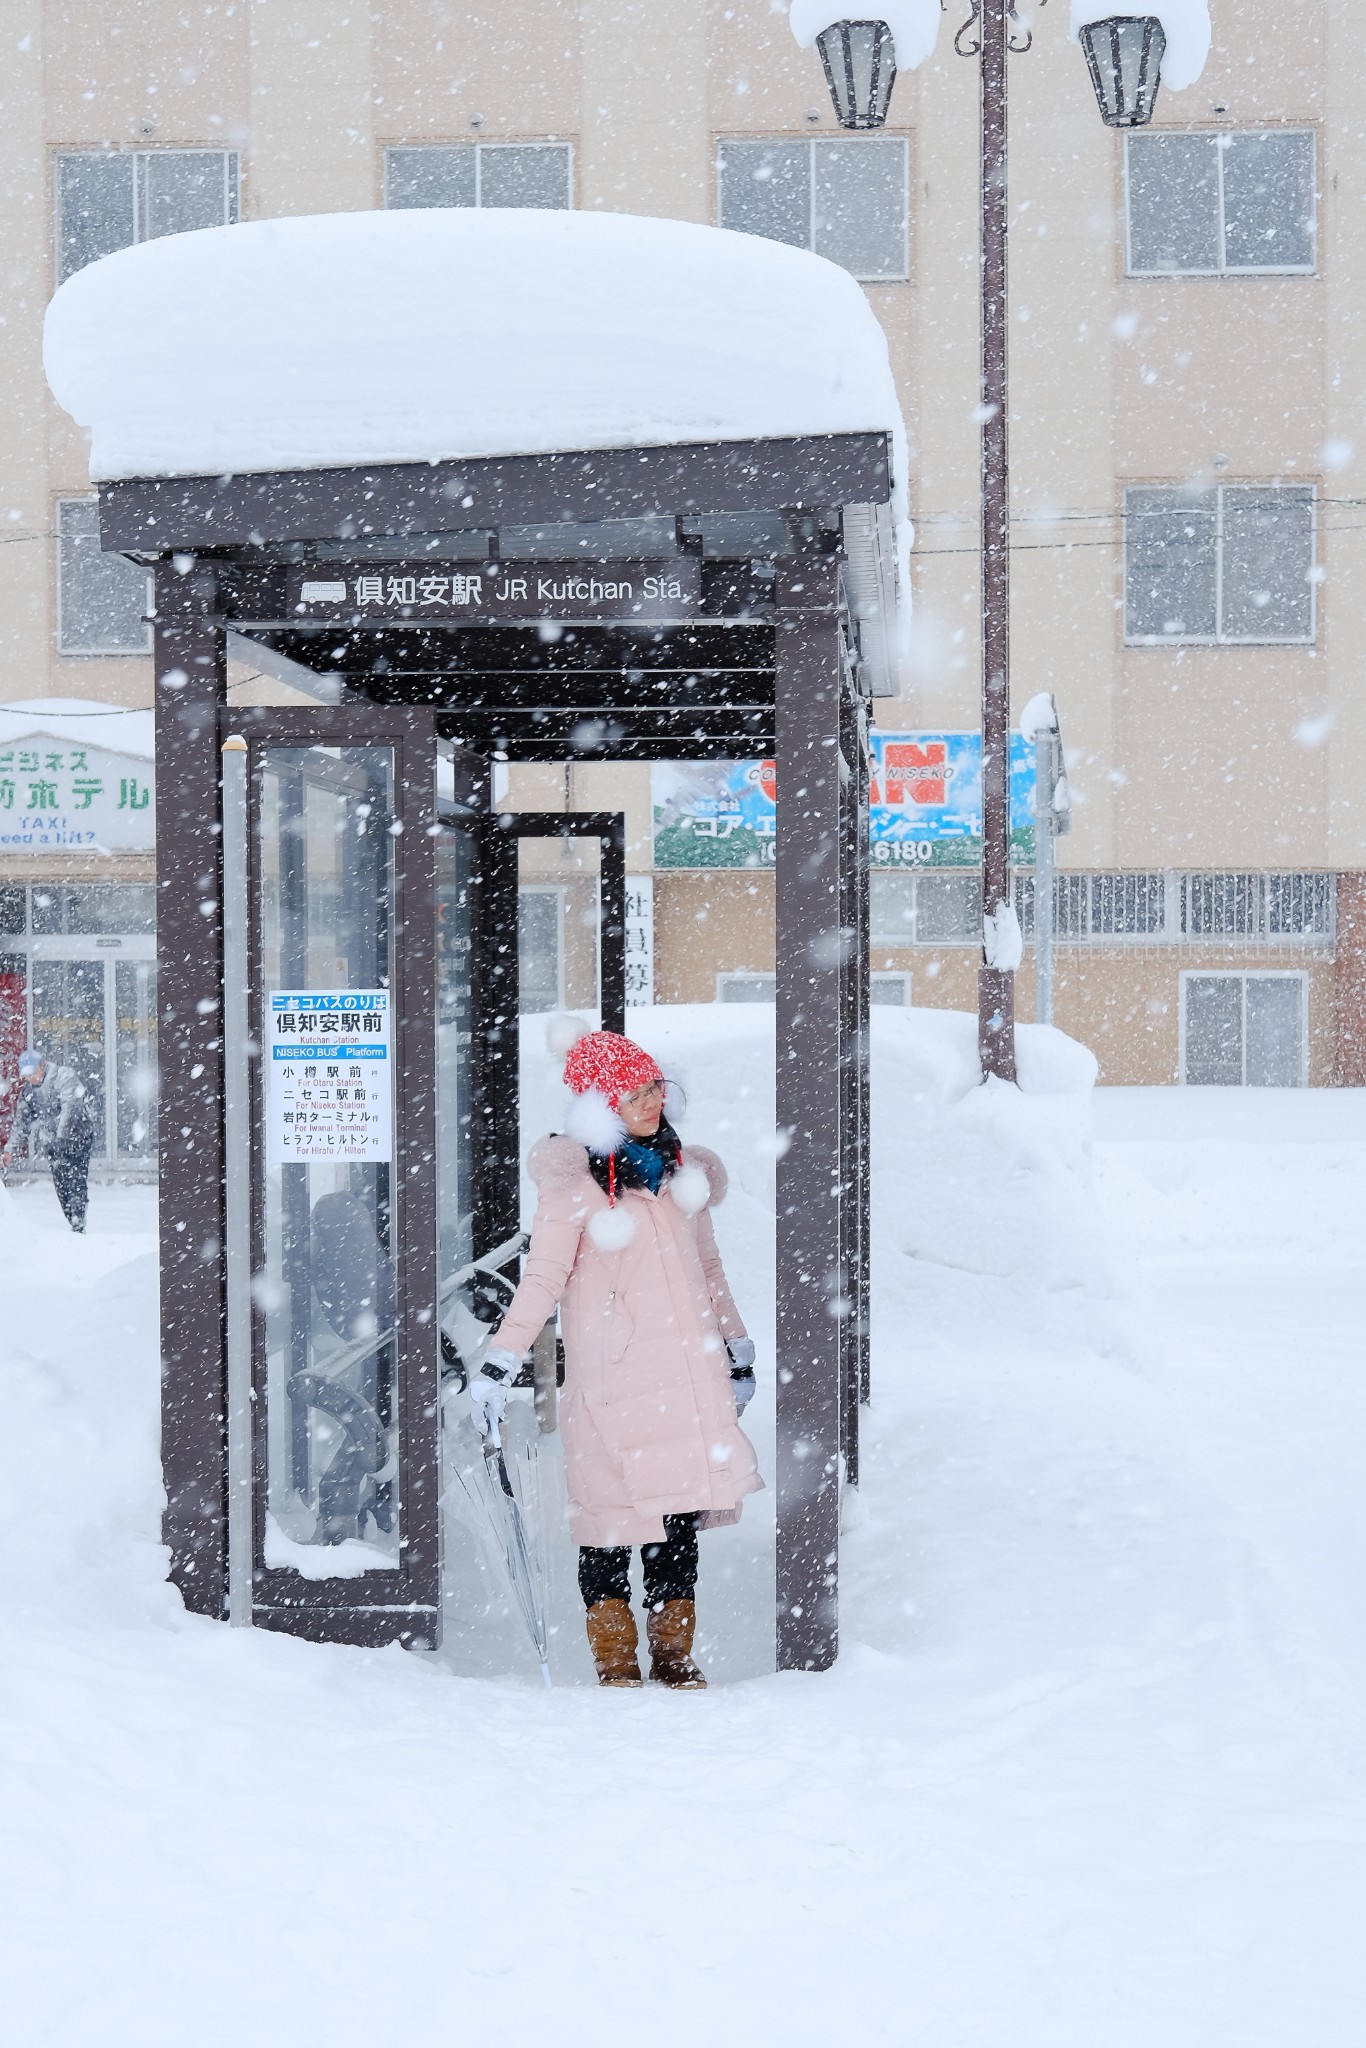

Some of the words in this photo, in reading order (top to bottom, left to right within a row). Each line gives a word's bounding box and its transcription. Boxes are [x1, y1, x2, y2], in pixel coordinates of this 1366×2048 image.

[496, 578, 527, 600] JR
[537, 578, 632, 600] Kutchan
[643, 577, 687, 600] Sta.
[887, 767, 954, 779] NISEKO
[20, 816, 67, 829] TAXI
[40, 834, 49, 844] a
[624, 890, 649, 1006] 社員募
[273, 996, 386, 1010] ニセコバスのりば
[300, 1036, 330, 1044] Kutchan
[276, 1048, 315, 1057] NISEKO
[317, 1048, 338, 1057] BUS
[346, 1047, 384, 1057] Platform
[298, 1079, 310, 1087] For
[313, 1079, 333, 1087] Otaru
[336, 1079, 363, 1087] Station
[295, 1101, 308, 1109] For
[311, 1101, 336, 1109] Niseko
[339, 1101, 366, 1109] Station
[294, 1124, 307, 1132] For
[336, 1124, 367, 1132] Terminal
[296, 1146, 309, 1154] For
[311, 1146, 333, 1154] Hirafu
[344, 1146, 366, 1154] Hilton
